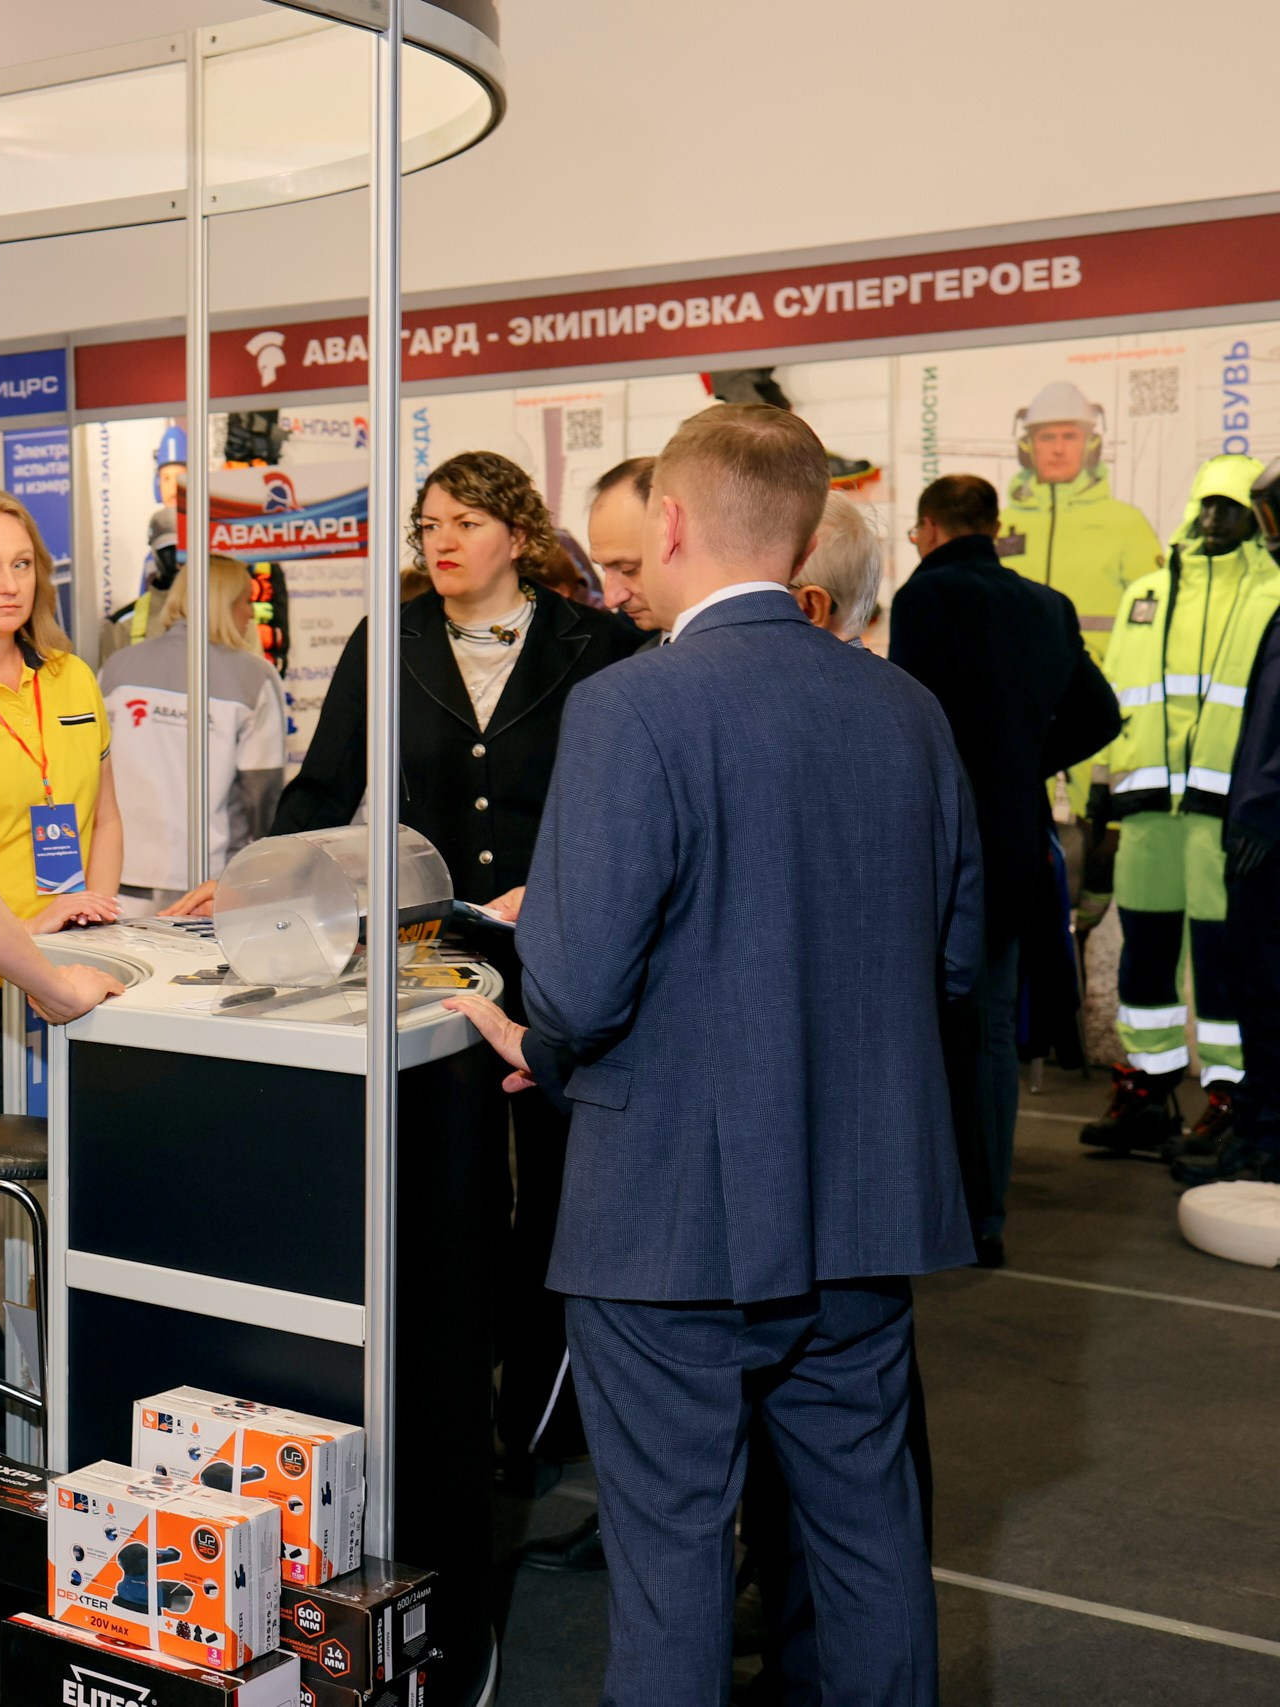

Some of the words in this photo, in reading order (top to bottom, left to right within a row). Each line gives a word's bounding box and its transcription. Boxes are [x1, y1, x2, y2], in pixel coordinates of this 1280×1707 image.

[302, 322, 479, 367] АВААРД
[507, 293, 763, 346] ЭКИПИРОВКА
[774, 256, 1082, 318] СУПЕРГЕРОЕВ
[1222, 340, 1250, 455] ОБУВЬ
[280, 417, 351, 438] ВАНГАРД
[413, 407, 430, 494] ЕЖДА
[211, 516, 359, 547] АВАНГАРД
[295, 1564, 301, 1573] 3
[57, 1588, 108, 1611] DEXTER
[298, 1607, 321, 1622] 600
[91, 1616, 109, 1629] 20V
[111, 1624, 128, 1636] MAX
[211, 1649, 218, 1658] 3
[327, 1646, 343, 1660] 14
[63, 1678, 148, 1707] ELITE
